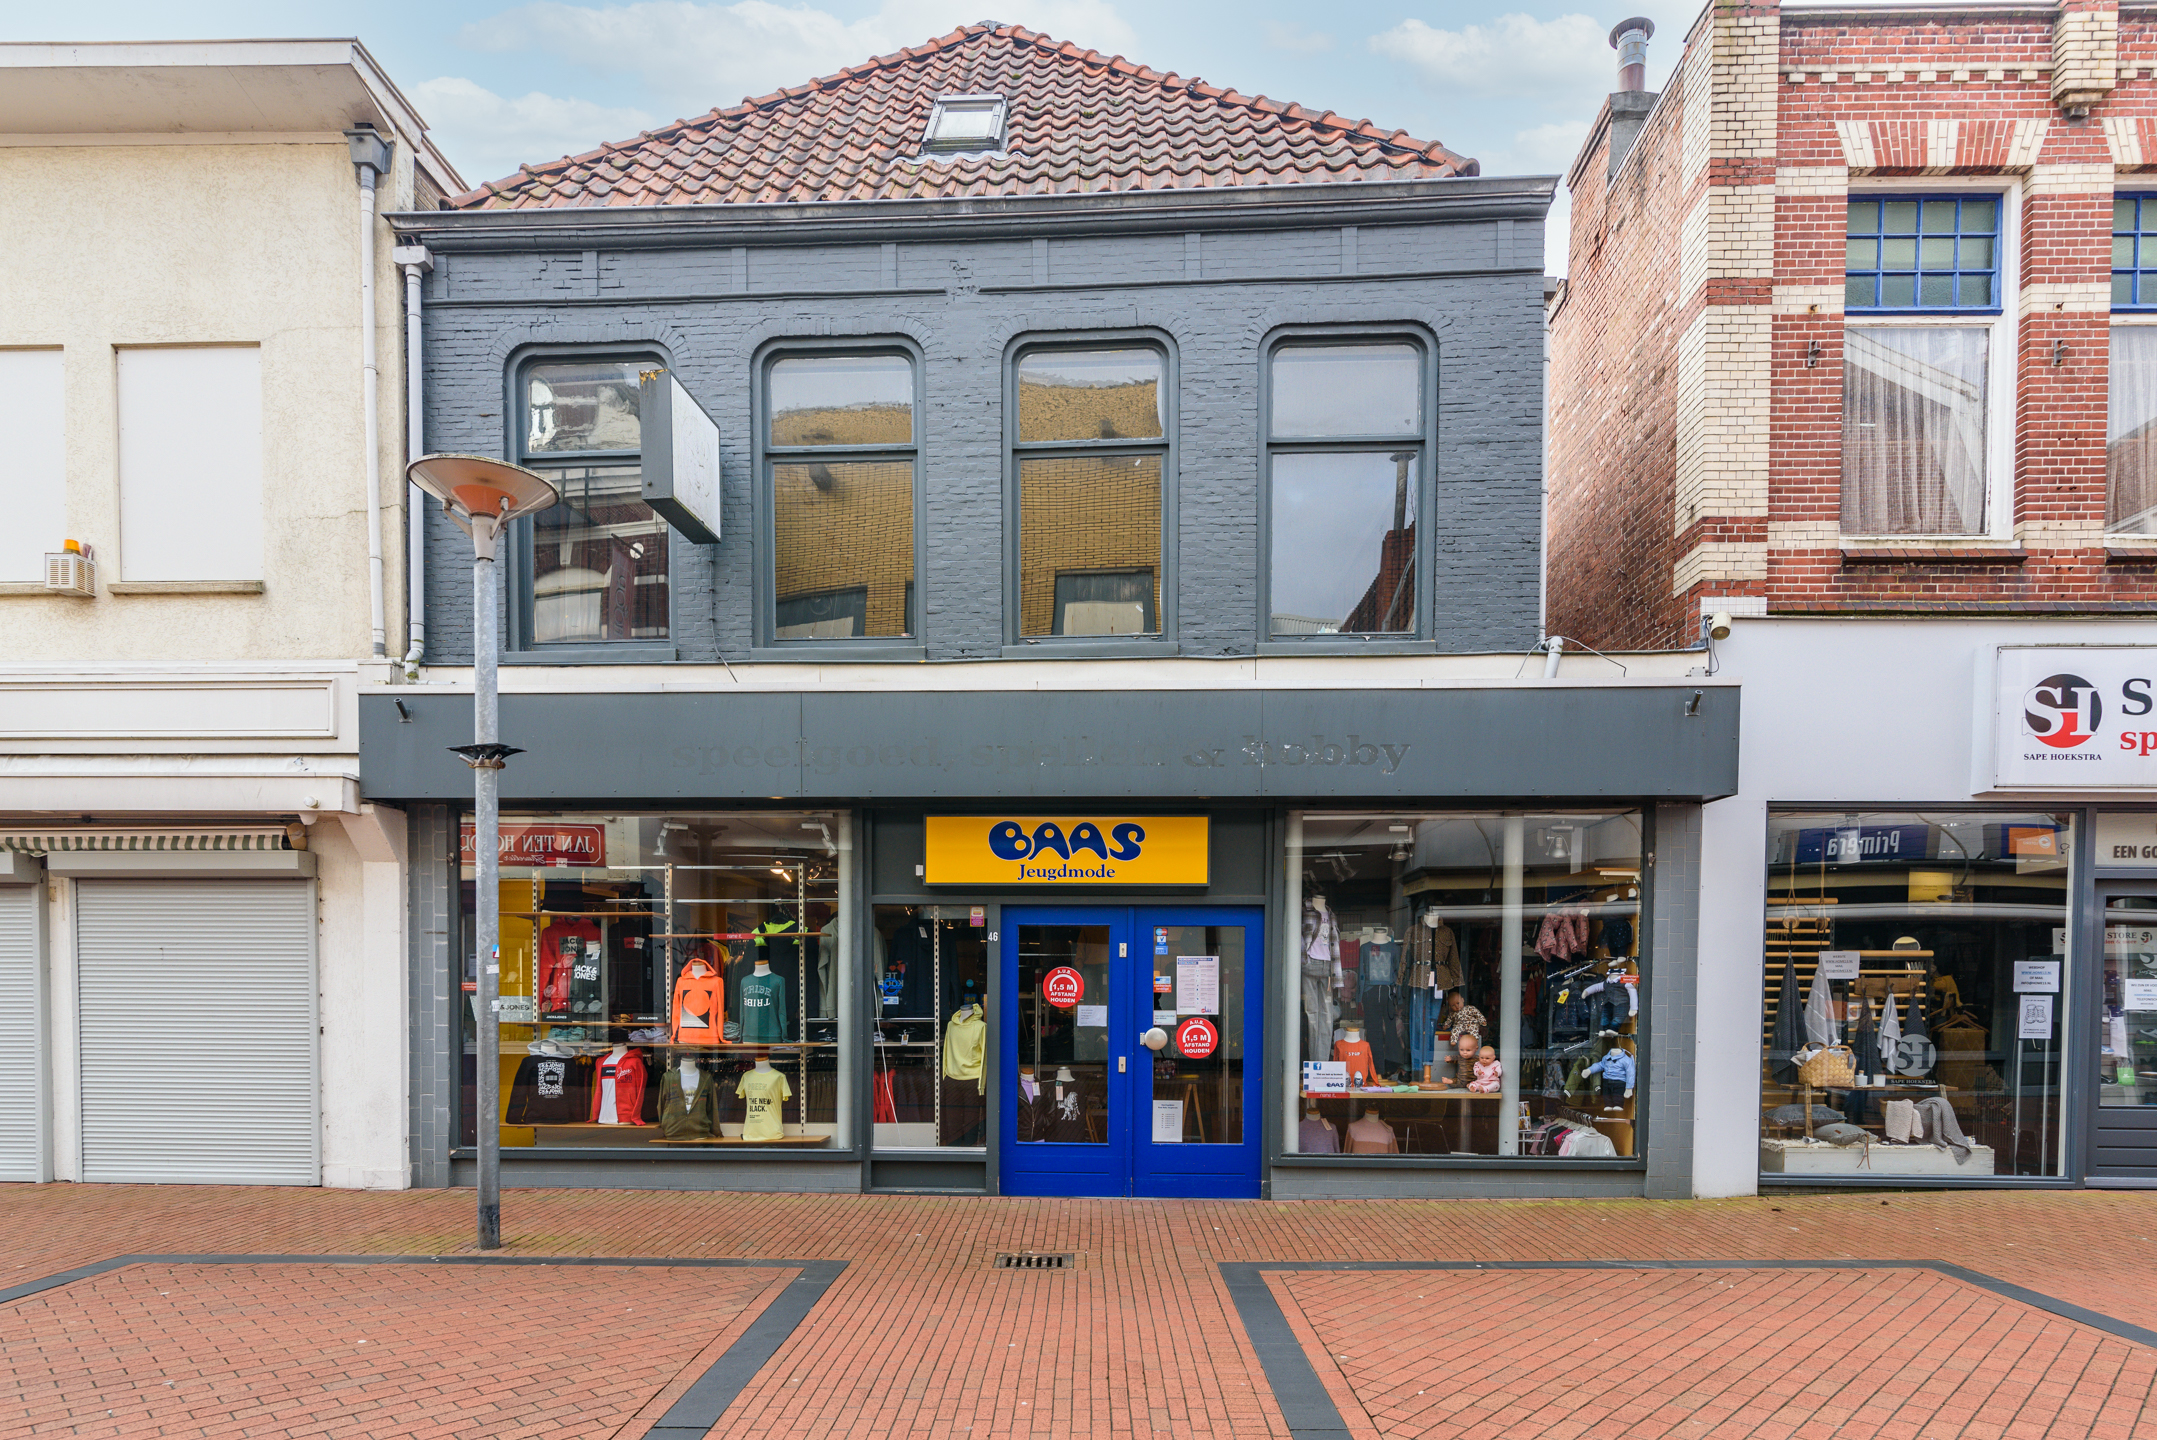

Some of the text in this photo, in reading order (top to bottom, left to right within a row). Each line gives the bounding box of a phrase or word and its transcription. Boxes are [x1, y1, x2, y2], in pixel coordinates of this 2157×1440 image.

[2121, 678, 2153, 716] S
[1182, 747, 1226, 768] &
[1241, 734, 1411, 775] hobby
[2023, 753, 2102, 761] SAPE HOEKSTRA
[988, 820, 1146, 861] BAAS
[2113, 845, 2137, 859] EEN
[1017, 863, 1116, 881] Jeugdmode
[988, 931, 999, 942] 46
[2106, 931, 2137, 939] STORE
[573, 971, 597, 981] JONES
[743, 984, 772, 997] TRIBE
[1052, 983, 1065, 991] 1,5
